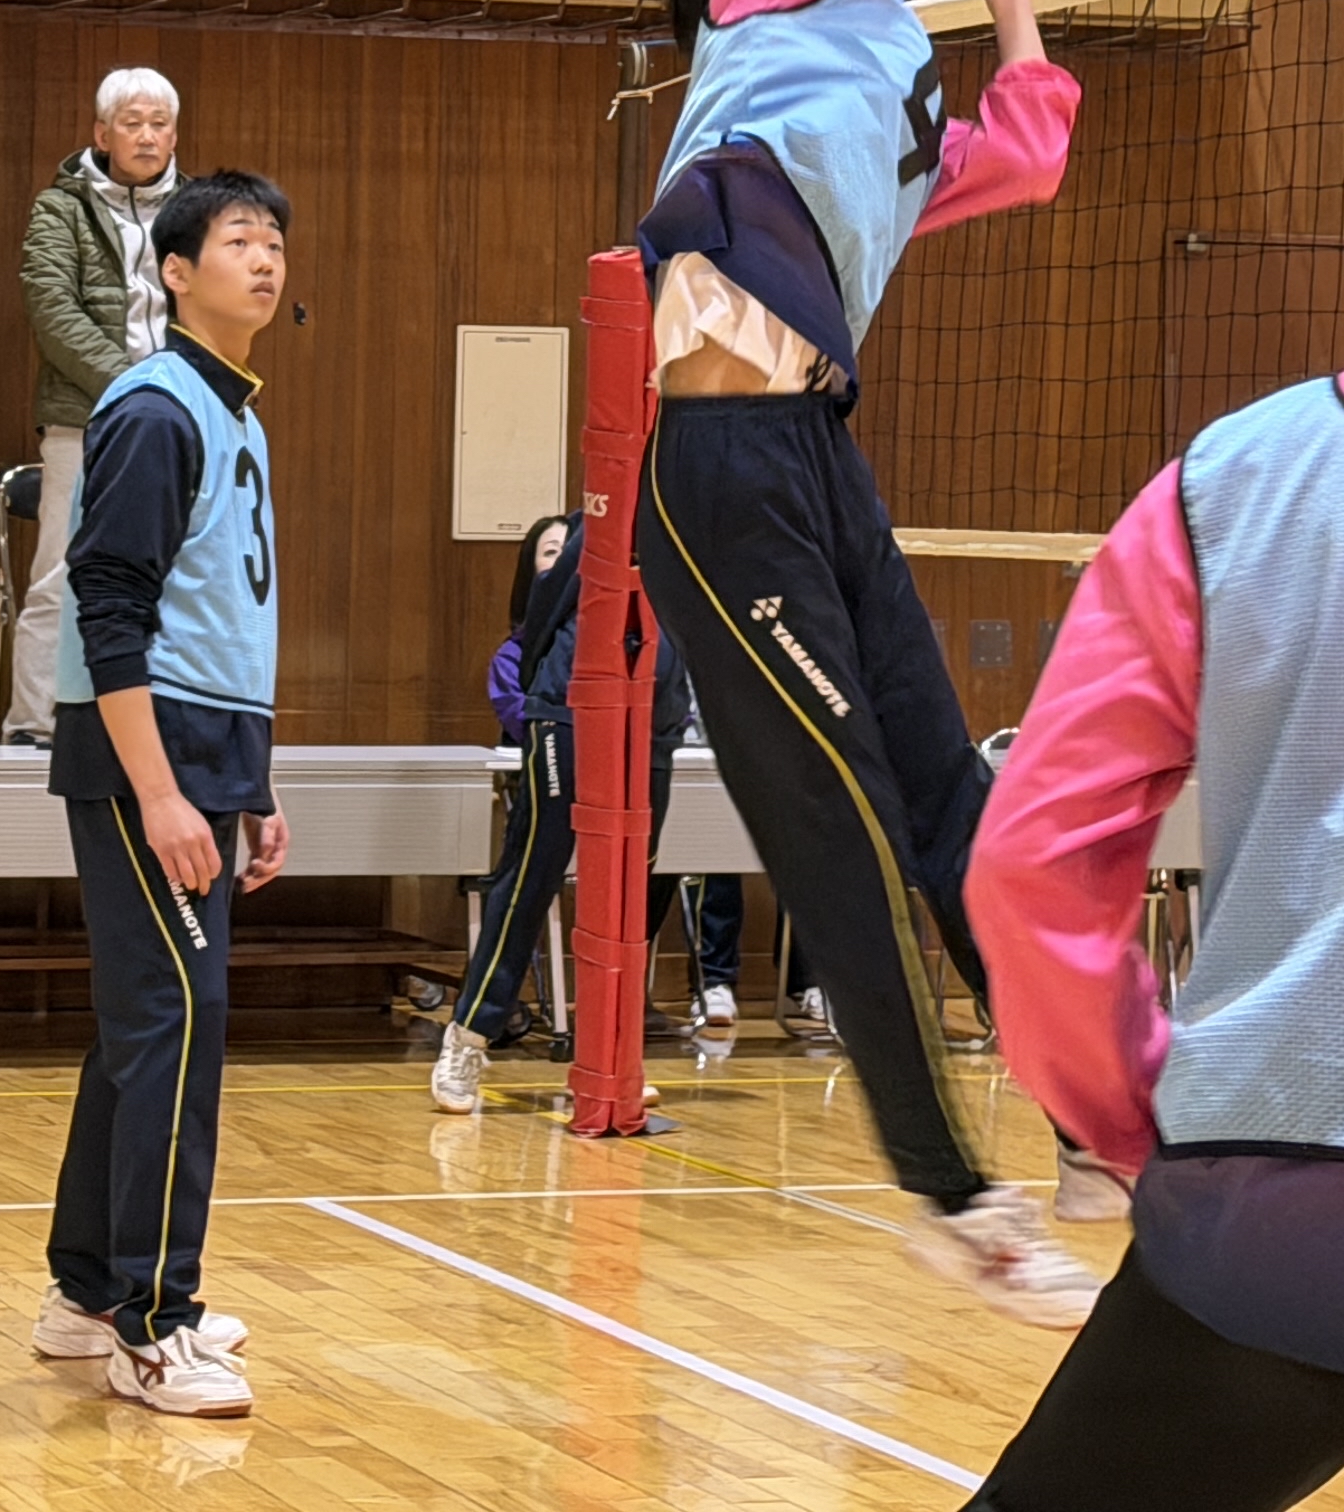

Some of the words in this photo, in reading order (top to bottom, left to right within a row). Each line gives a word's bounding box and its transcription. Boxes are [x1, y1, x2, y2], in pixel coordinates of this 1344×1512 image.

[234, 444, 271, 607] 3
[770, 619, 853, 718] YAMANOTE
[167, 877, 209, 950] MANOTE
